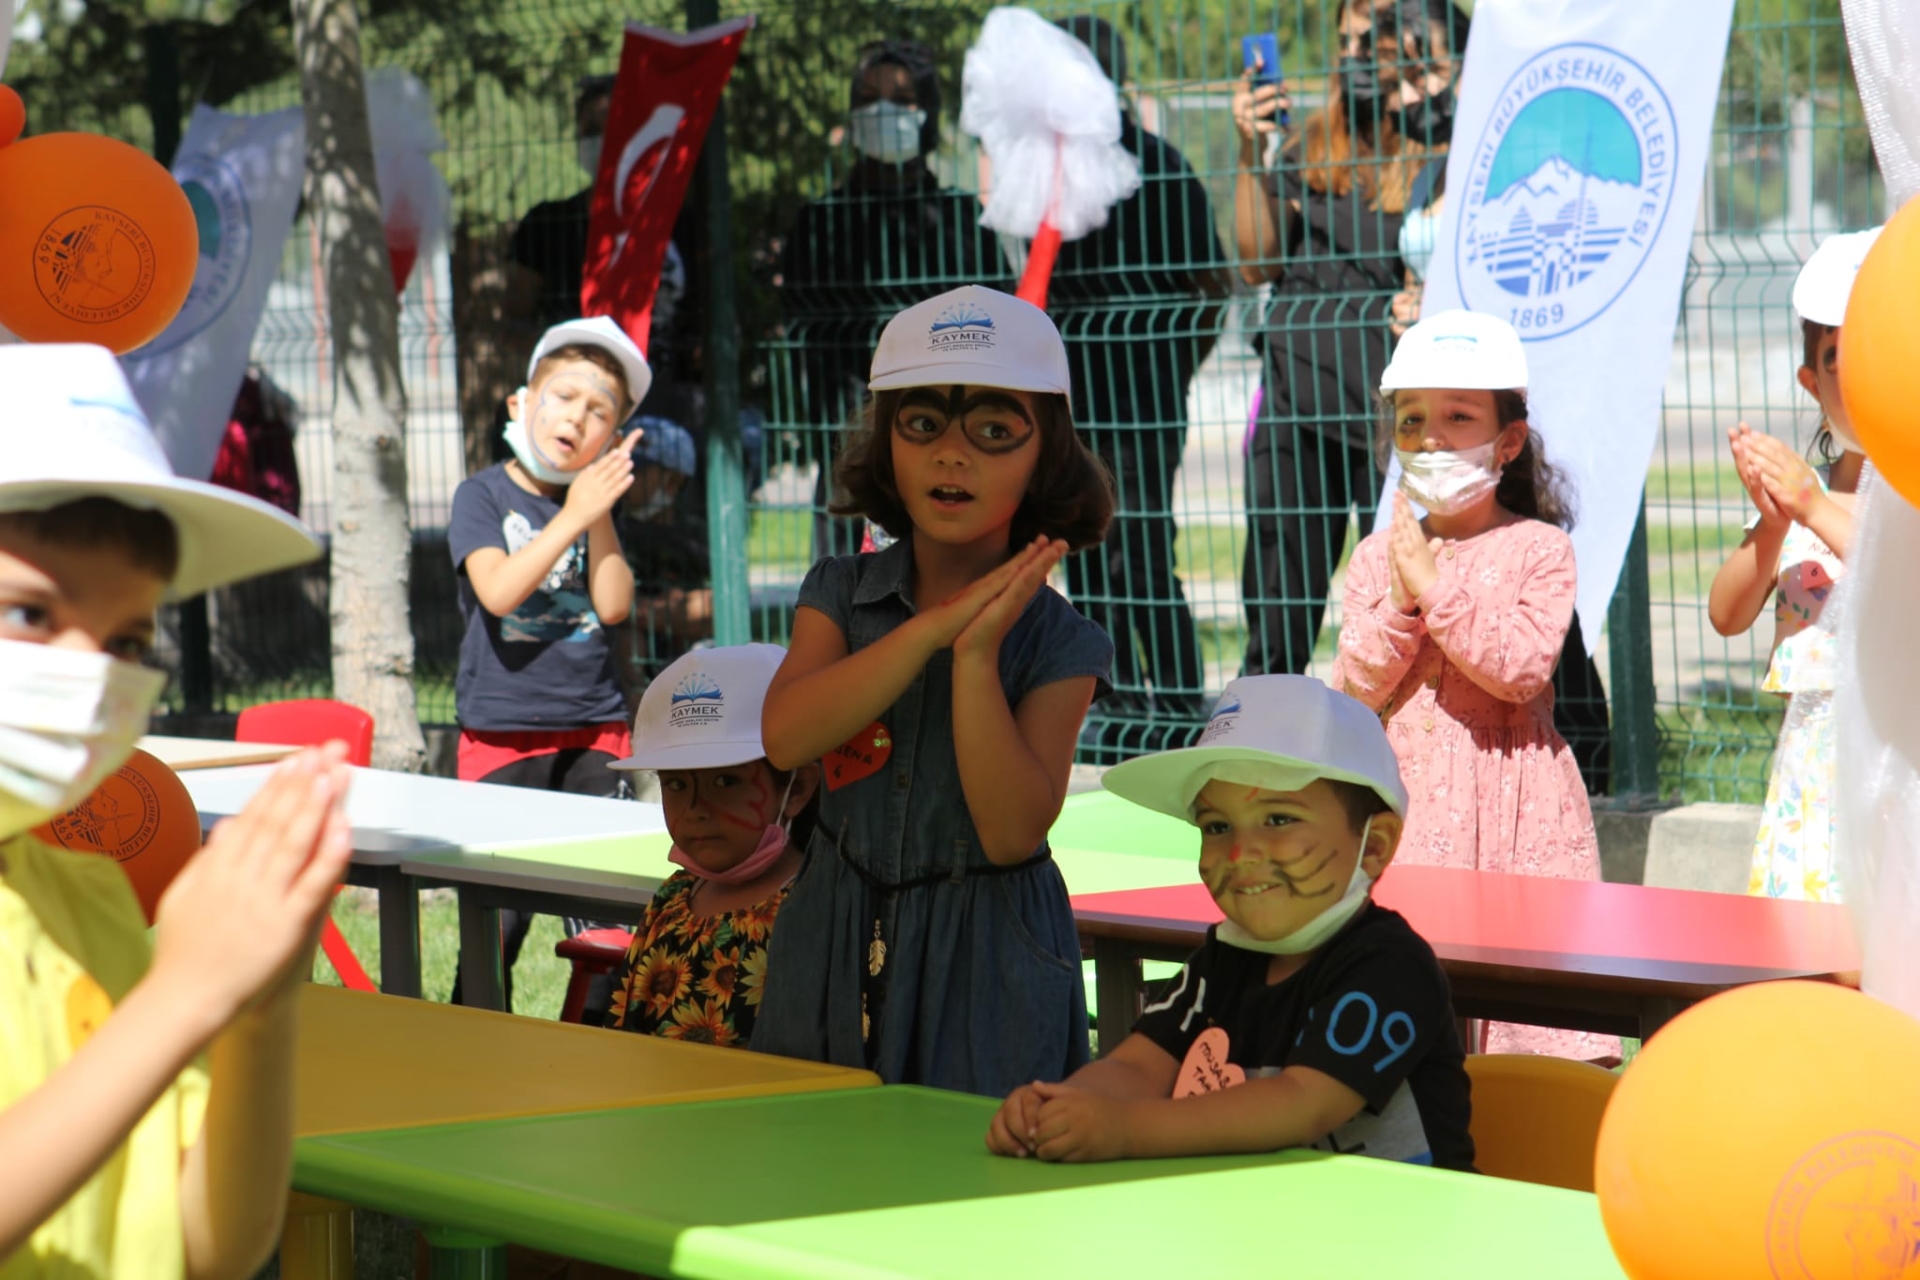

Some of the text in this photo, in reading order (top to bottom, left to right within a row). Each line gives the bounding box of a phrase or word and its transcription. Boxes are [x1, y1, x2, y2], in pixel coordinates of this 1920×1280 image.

[1625, 87, 1668, 248] BELEDİYESİ
[1510, 303, 1564, 329] 1869
[931, 332, 991, 345] KAYMEK
[671, 706, 719, 720] KAYMEK
[55, 818, 74, 840] 869
